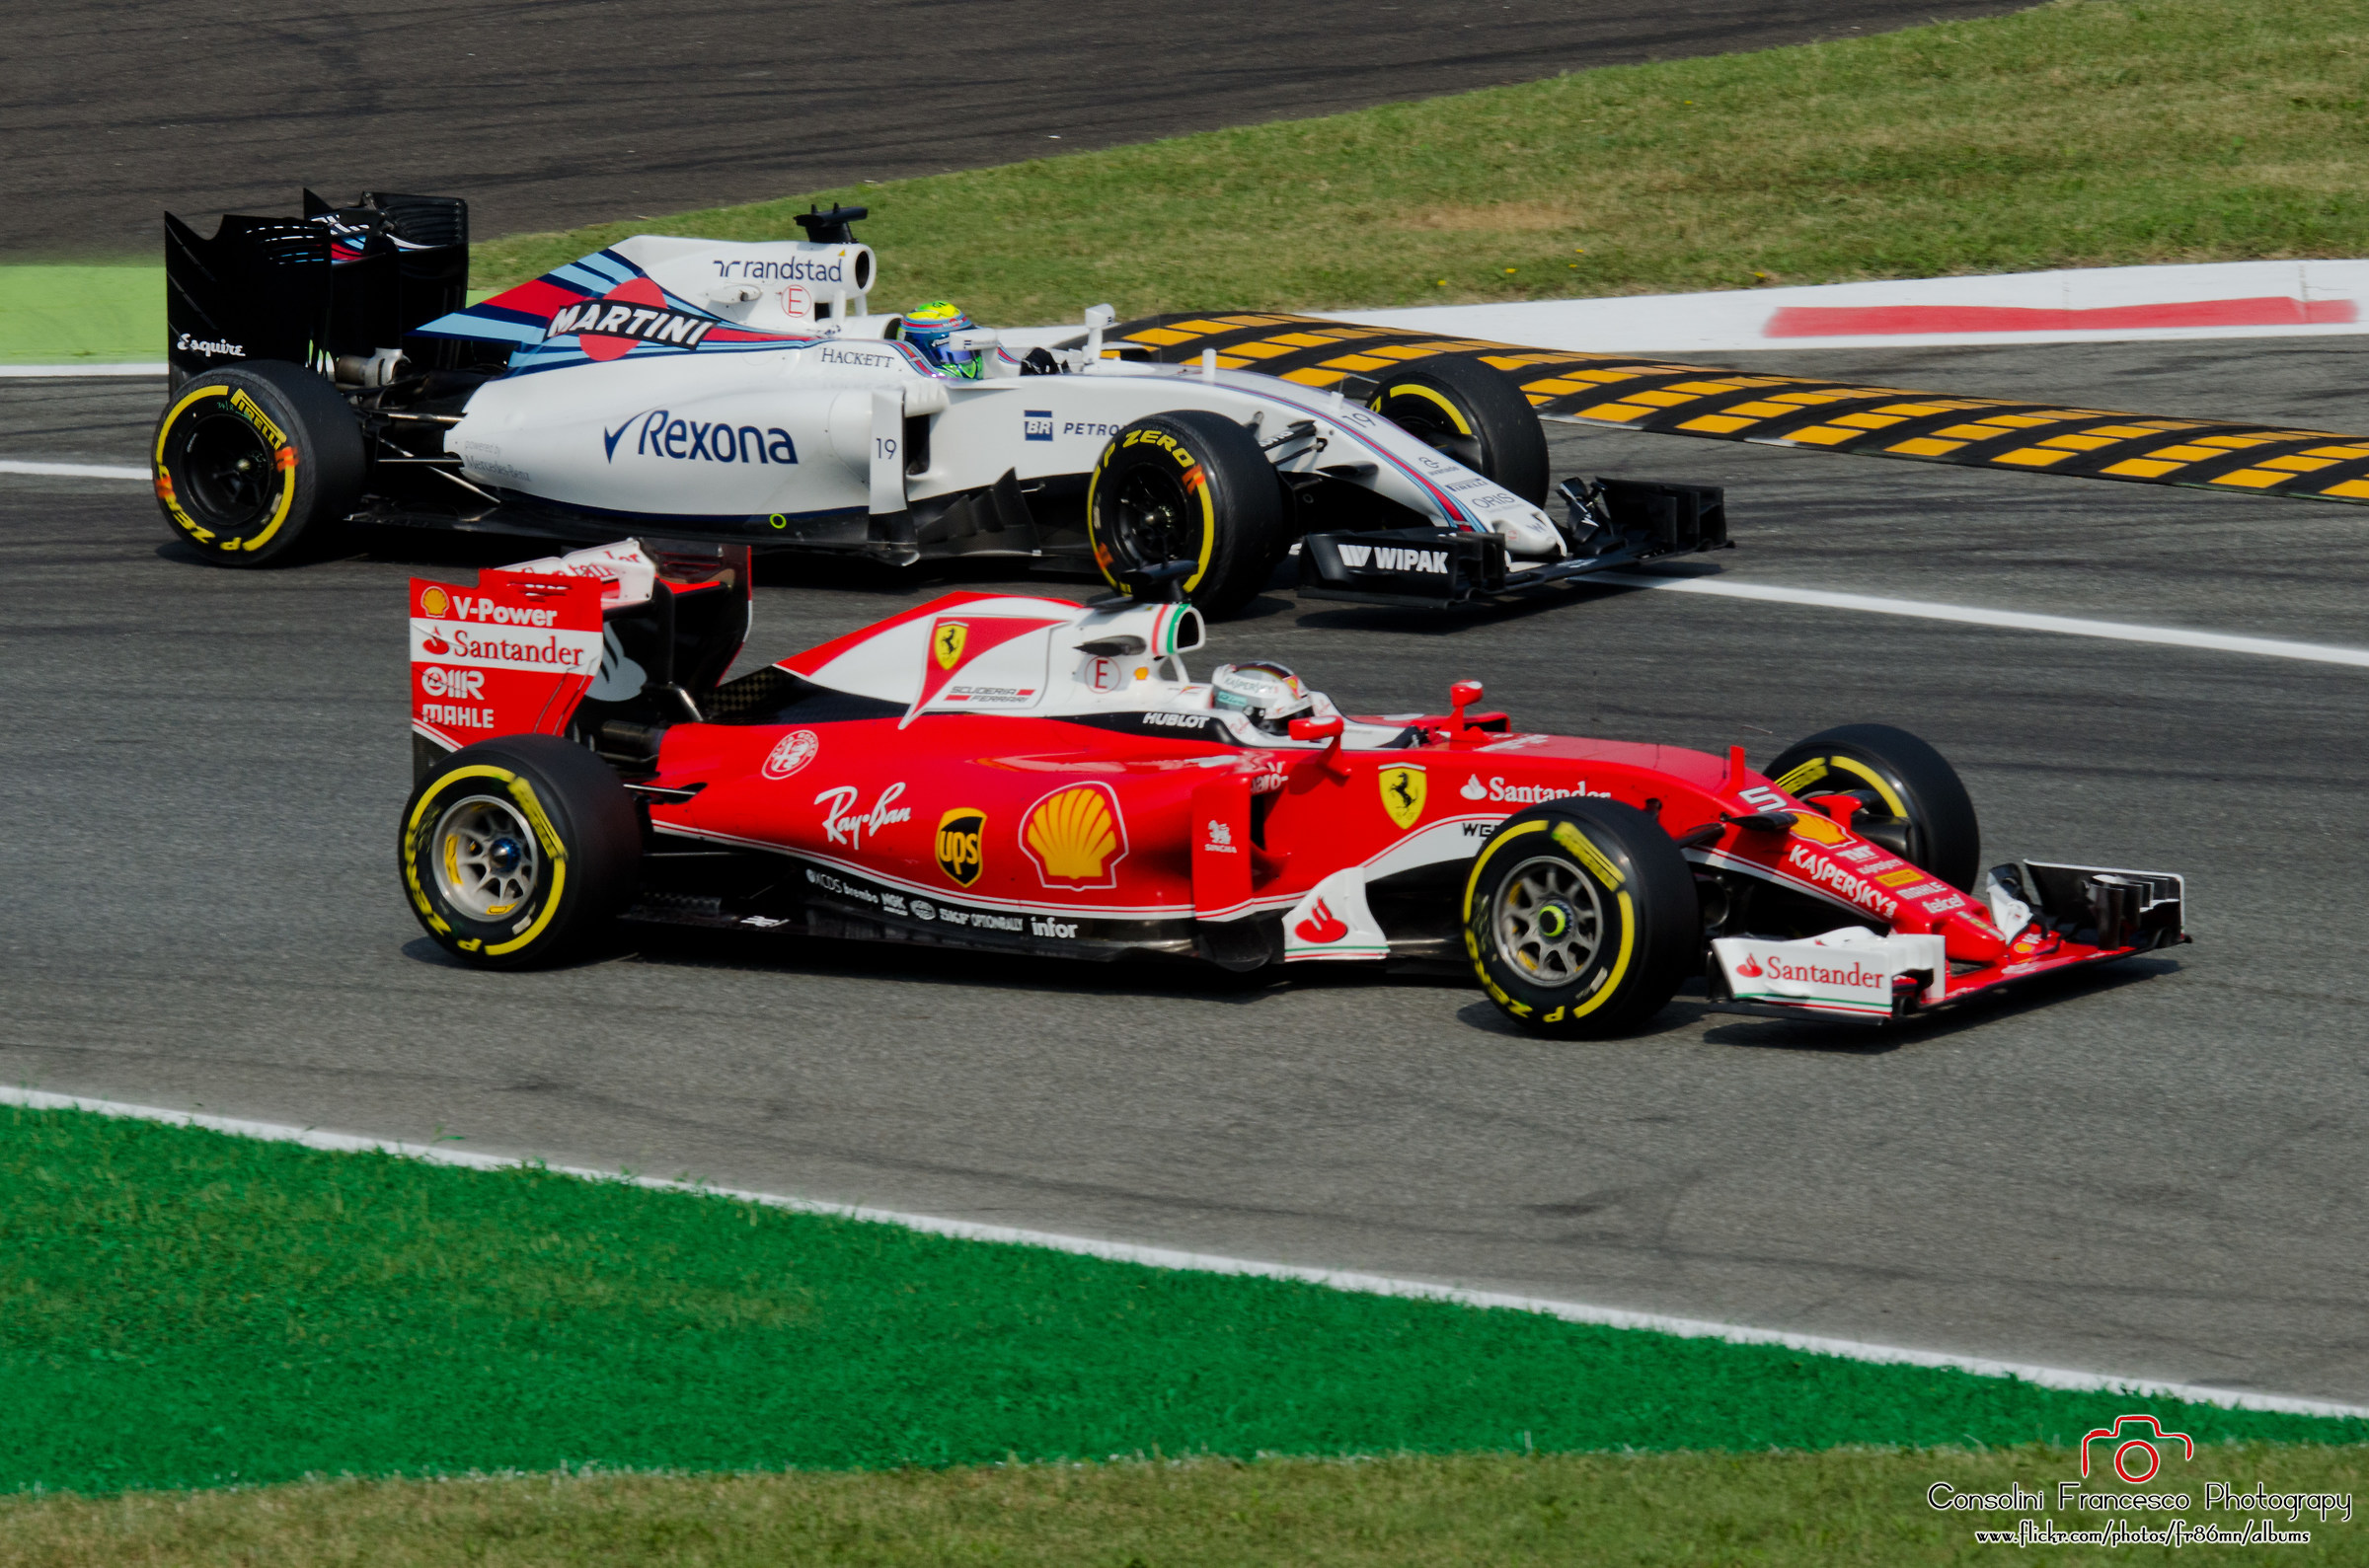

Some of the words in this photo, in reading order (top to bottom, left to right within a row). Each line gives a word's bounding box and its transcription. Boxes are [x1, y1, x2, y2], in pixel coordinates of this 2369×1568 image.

[743, 257, 842, 282] randstad
[788, 288, 803, 315] E
[548, 304, 714, 346] MARTINI
[177, 334, 247, 357] Esquire
[820, 347, 894, 369] HACKETT
[230, 388, 288, 450] PIRELLI
[1025, 421, 1053, 435] BR
[1063, 422, 1124, 437] PETRO
[1341, 412, 1376, 428] 19
[638, 410, 800, 465] Rexona
[876, 437, 898, 461] 19
[1122, 429, 1196, 469] ZERO
[1445, 478, 1488, 492] PIRELLI
[1472, 492, 1516, 509] ORIS
[1374, 547, 1448, 574] WIPAK
[452, 595, 557, 627] V-Power
[453, 630, 584, 666] Santander
[1095, 659, 1108, 689] E
[950, 686, 1017, 695] SCUDERIA
[970, 695, 1029, 704] FERRARI
[421, 704, 495, 728] MAHLE
[1142, 712, 1210, 729] HUBLOT
[1737, 785, 1788, 812] 5
[939, 830, 978, 875] ups
[1789, 844, 1890, 912] KASPERSKY
[1921, 893, 1965, 914] telcel
[1031, 916, 1079, 938] infor
[1767, 956, 1885, 989] Santander
